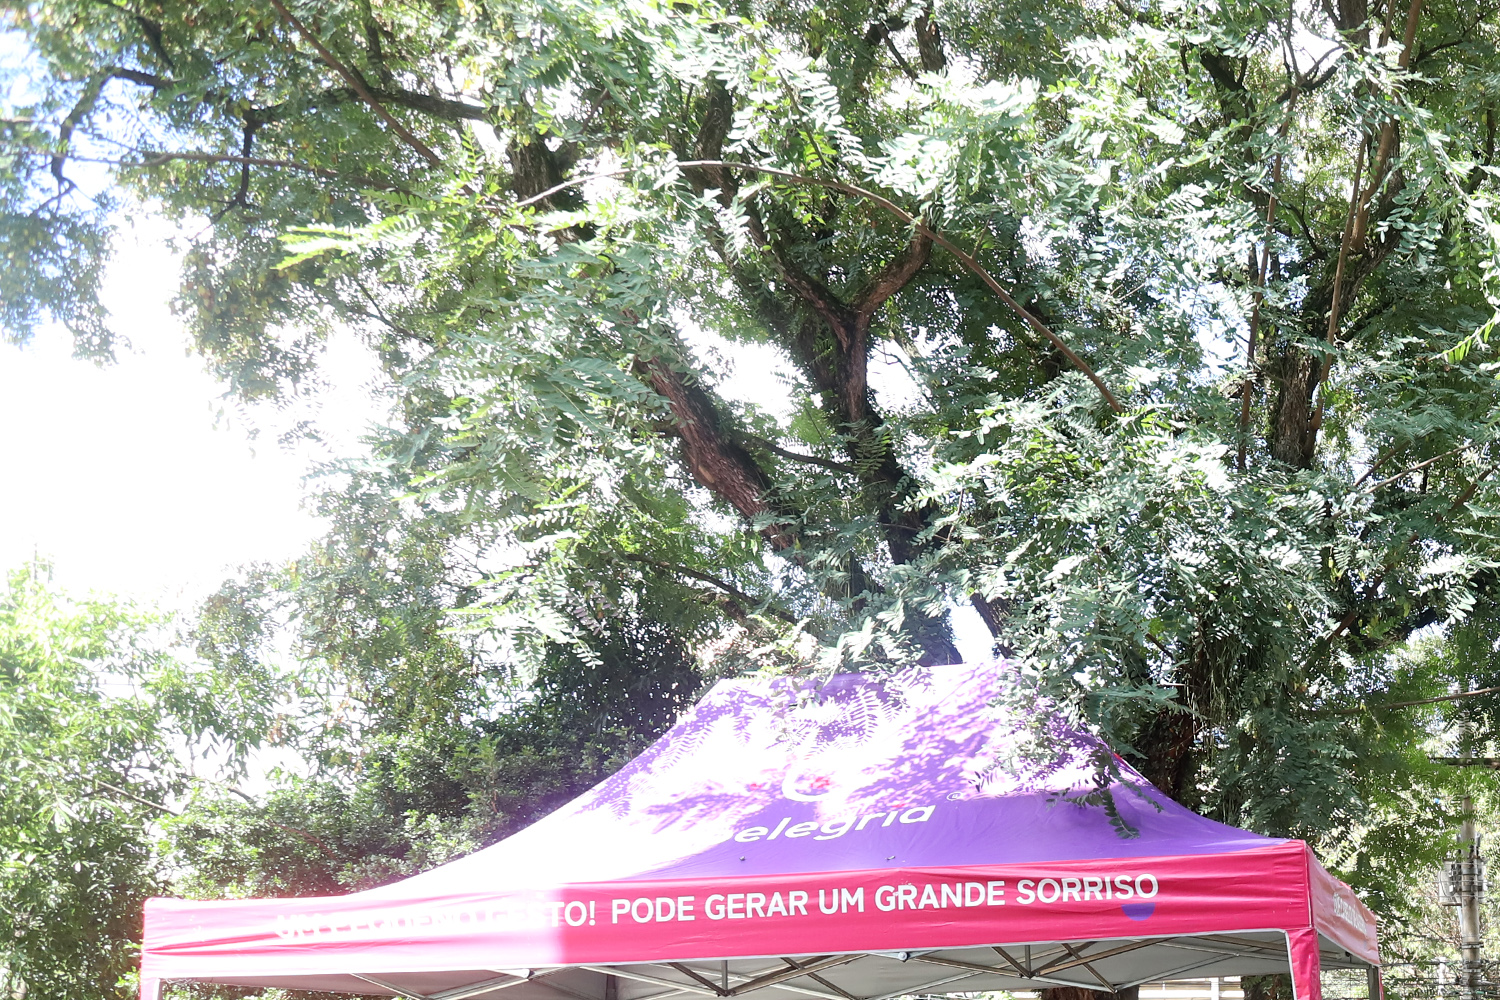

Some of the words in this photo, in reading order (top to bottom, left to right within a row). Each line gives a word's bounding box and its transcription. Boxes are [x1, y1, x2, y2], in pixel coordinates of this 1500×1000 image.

[726, 804, 936, 843] elegria
[611, 896, 695, 924] PODE
[704, 891, 808, 920] GERAR
[818, 887, 865, 915] UM
[875, 880, 1006, 912] GRANDE
[1015, 873, 1159, 905] SORRISO
